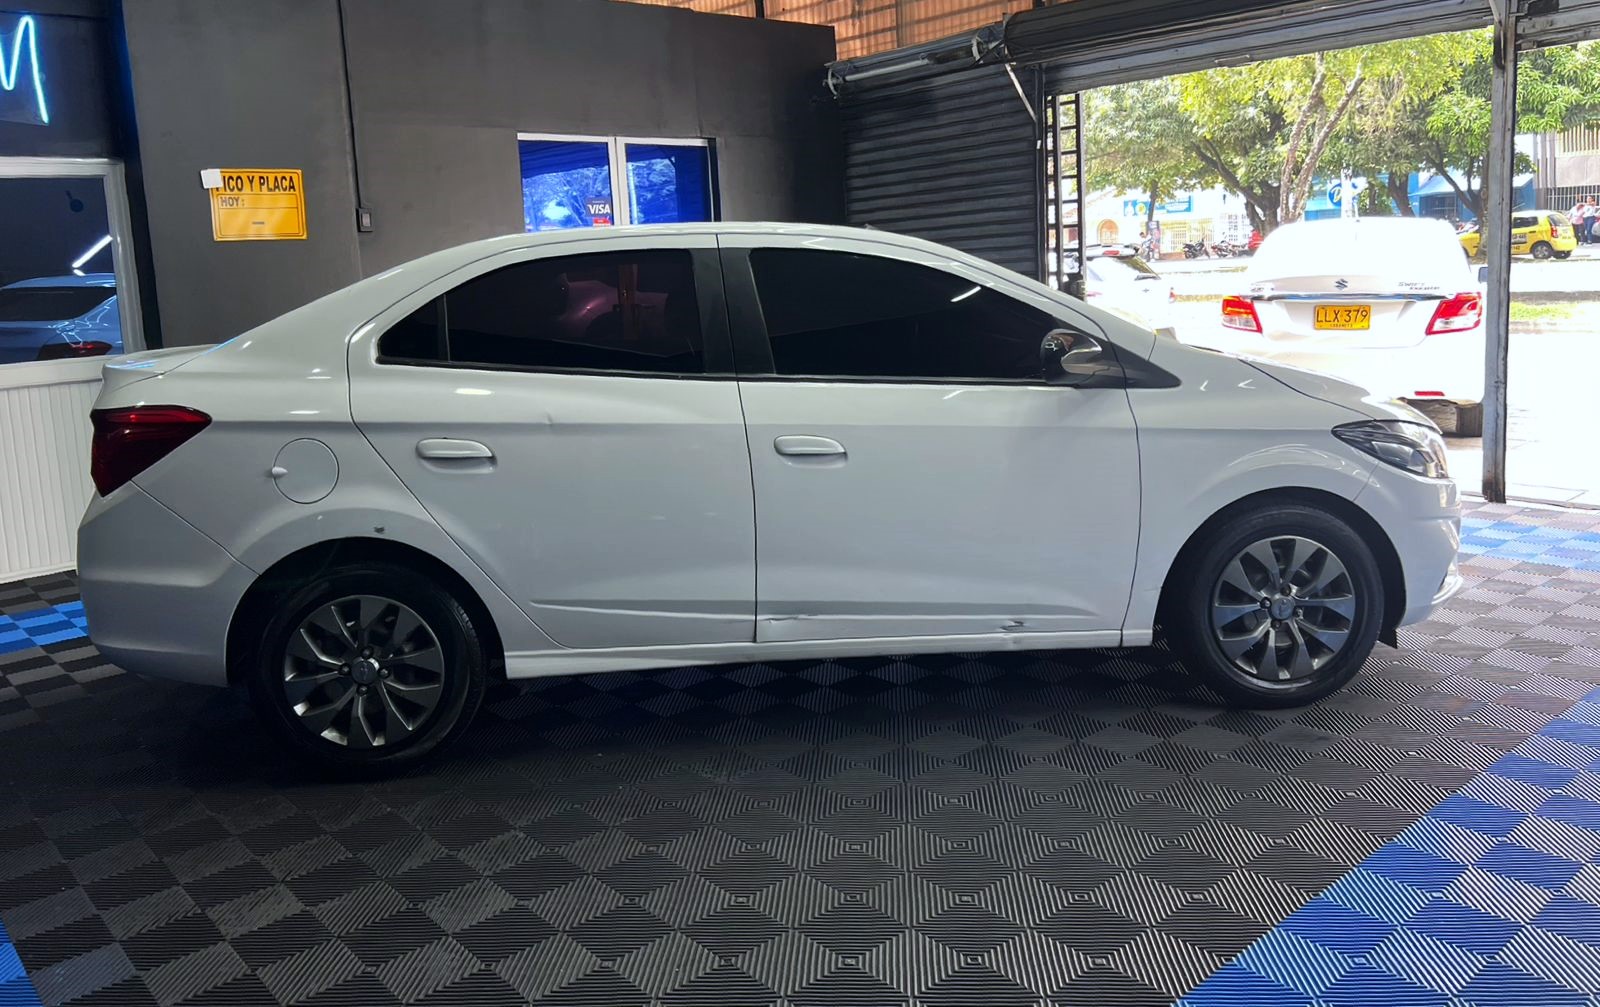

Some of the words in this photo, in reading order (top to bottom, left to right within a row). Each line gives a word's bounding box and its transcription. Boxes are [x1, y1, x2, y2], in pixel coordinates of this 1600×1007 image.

[247, 175, 255, 192] Y
[258, 175, 296, 192] PLACA
[587, 204, 611, 214] VISA
[1316, 309, 1340, 323] LLX
[1344, 309, 1368, 323] 379
